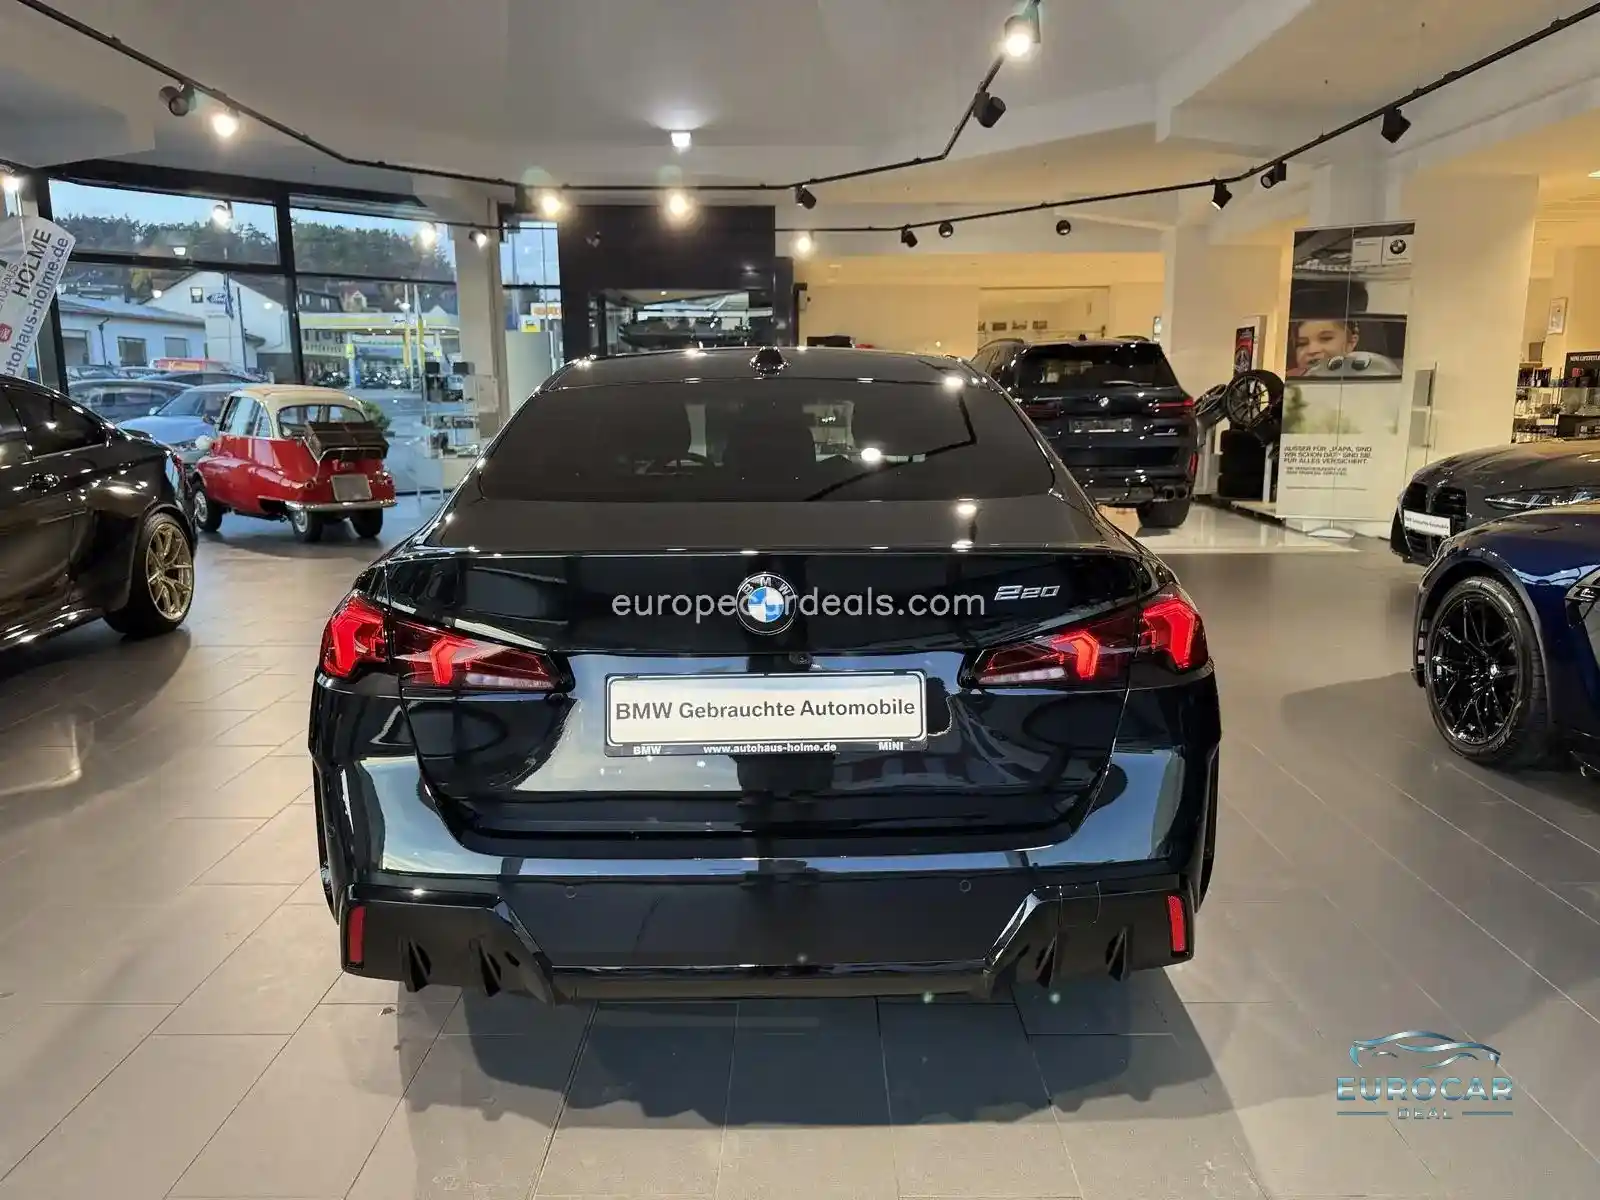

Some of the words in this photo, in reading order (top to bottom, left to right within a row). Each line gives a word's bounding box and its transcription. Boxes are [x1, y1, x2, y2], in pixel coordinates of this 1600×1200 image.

[12, 228, 52, 298] HOLME
[741, 576, 792, 596] BMW
[994, 584, 1060, 601] 220
[616, 702, 673, 720] BMW
[679, 700, 796, 719] Gebrauchte
[799, 698, 916, 717] Automobile
[633, 745, 662, 755] BMW
[703, 742, 837, 754] www.autohaus-holme.de
[878, 741, 904, 751] MINI
